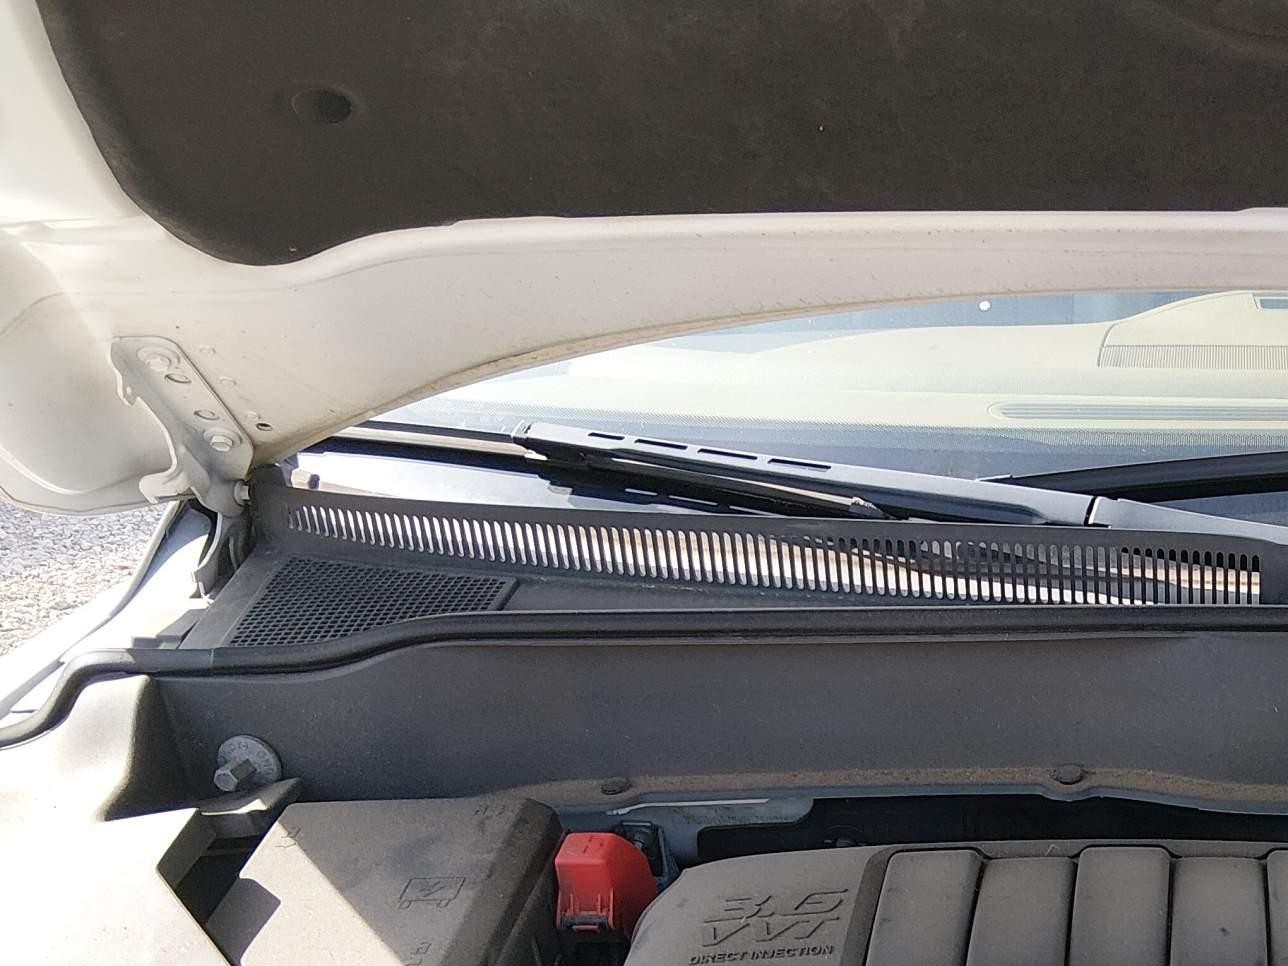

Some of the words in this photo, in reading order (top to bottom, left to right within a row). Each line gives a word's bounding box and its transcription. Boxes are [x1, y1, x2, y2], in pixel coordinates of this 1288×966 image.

[703, 888, 848, 923] 3.6
[702, 917, 841, 948] VVT
[688, 952, 750, 966] DIRECT
[750, 945, 835, 961] INJECTION
